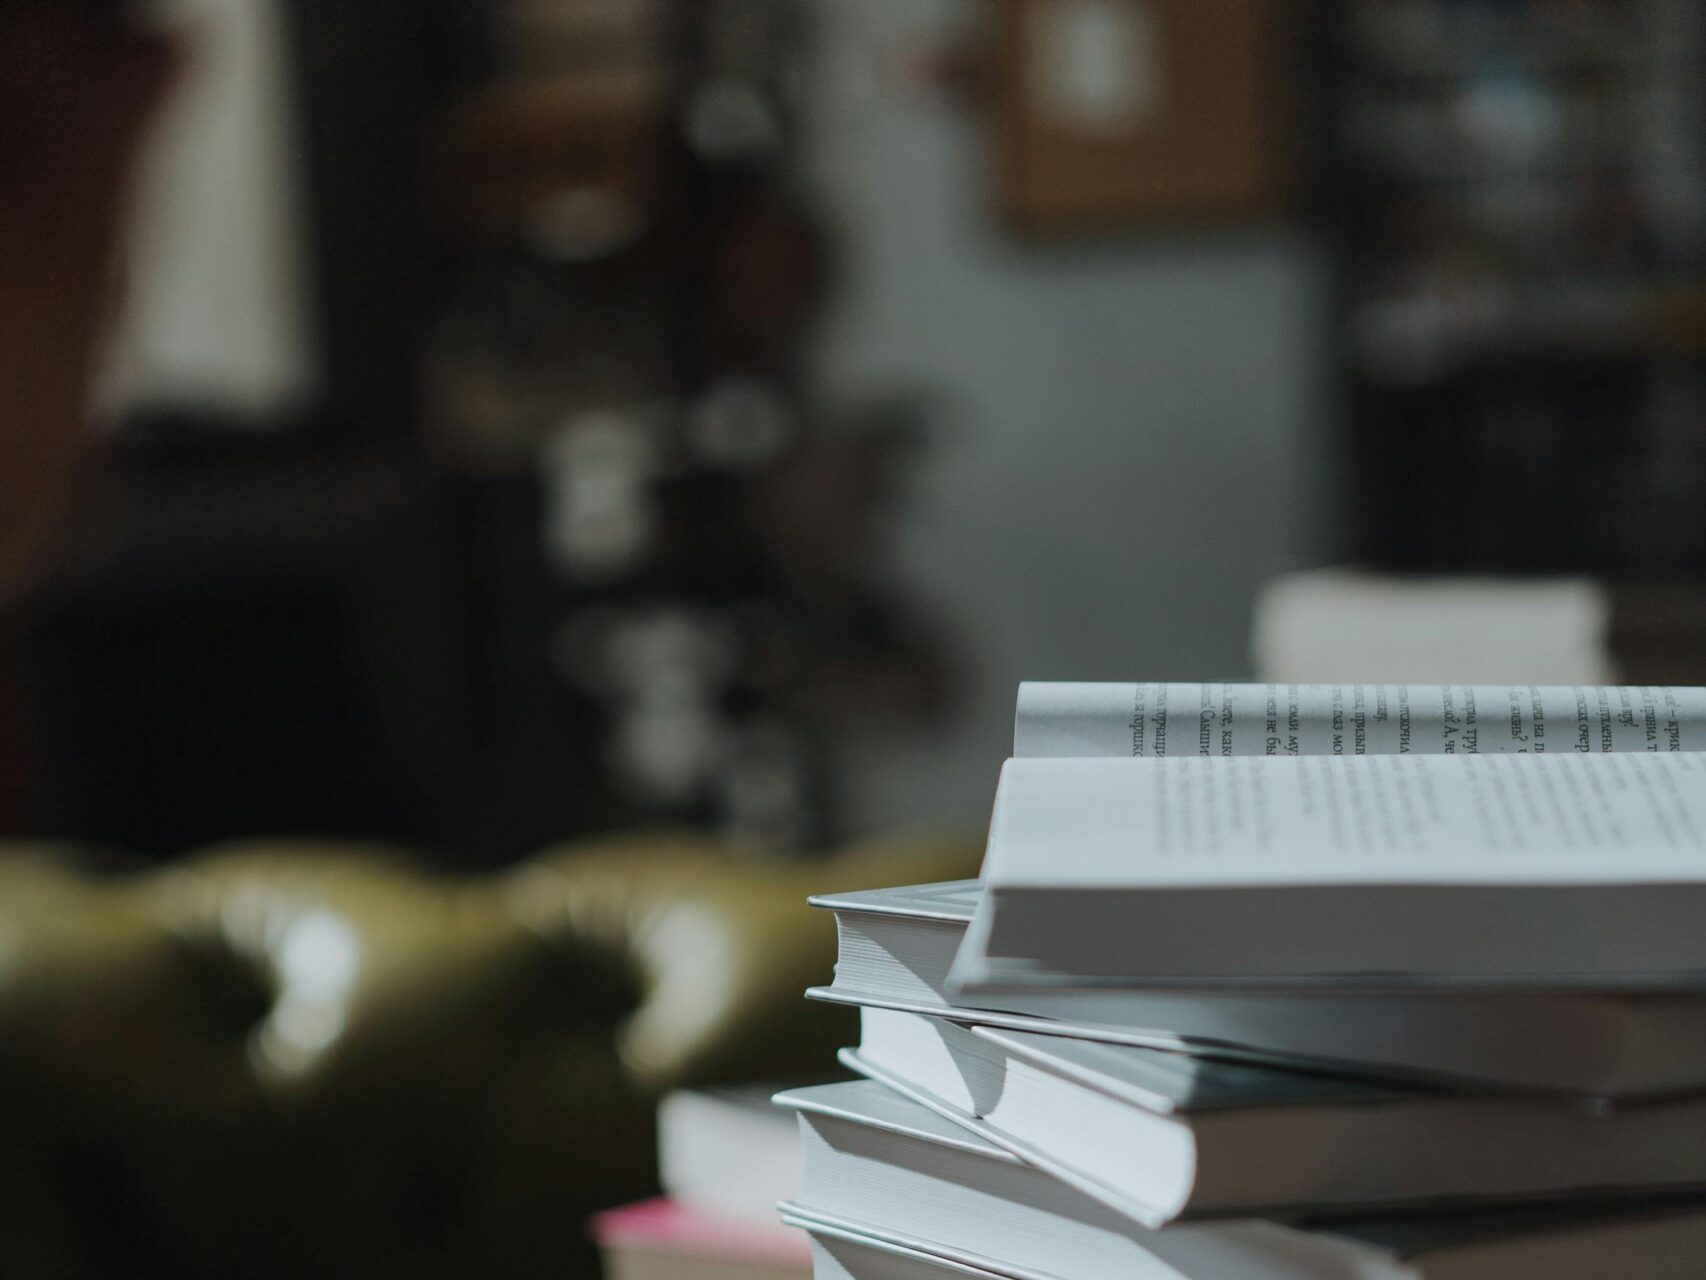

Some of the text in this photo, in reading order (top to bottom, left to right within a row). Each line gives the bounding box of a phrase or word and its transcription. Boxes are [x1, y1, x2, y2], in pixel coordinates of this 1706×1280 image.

[1266, 719, 1277, 735] не
[1288, 703, 1299, 731] земли
[1333, 709, 1343, 730] глаз
[1399, 703, 1411, 755] отскочил
[1351, 712, 1366, 756] призыв
[1443, 724, 1459, 738] А,
[1534, 724, 1545, 738] на
[1575, 723, 1590, 754] очер
